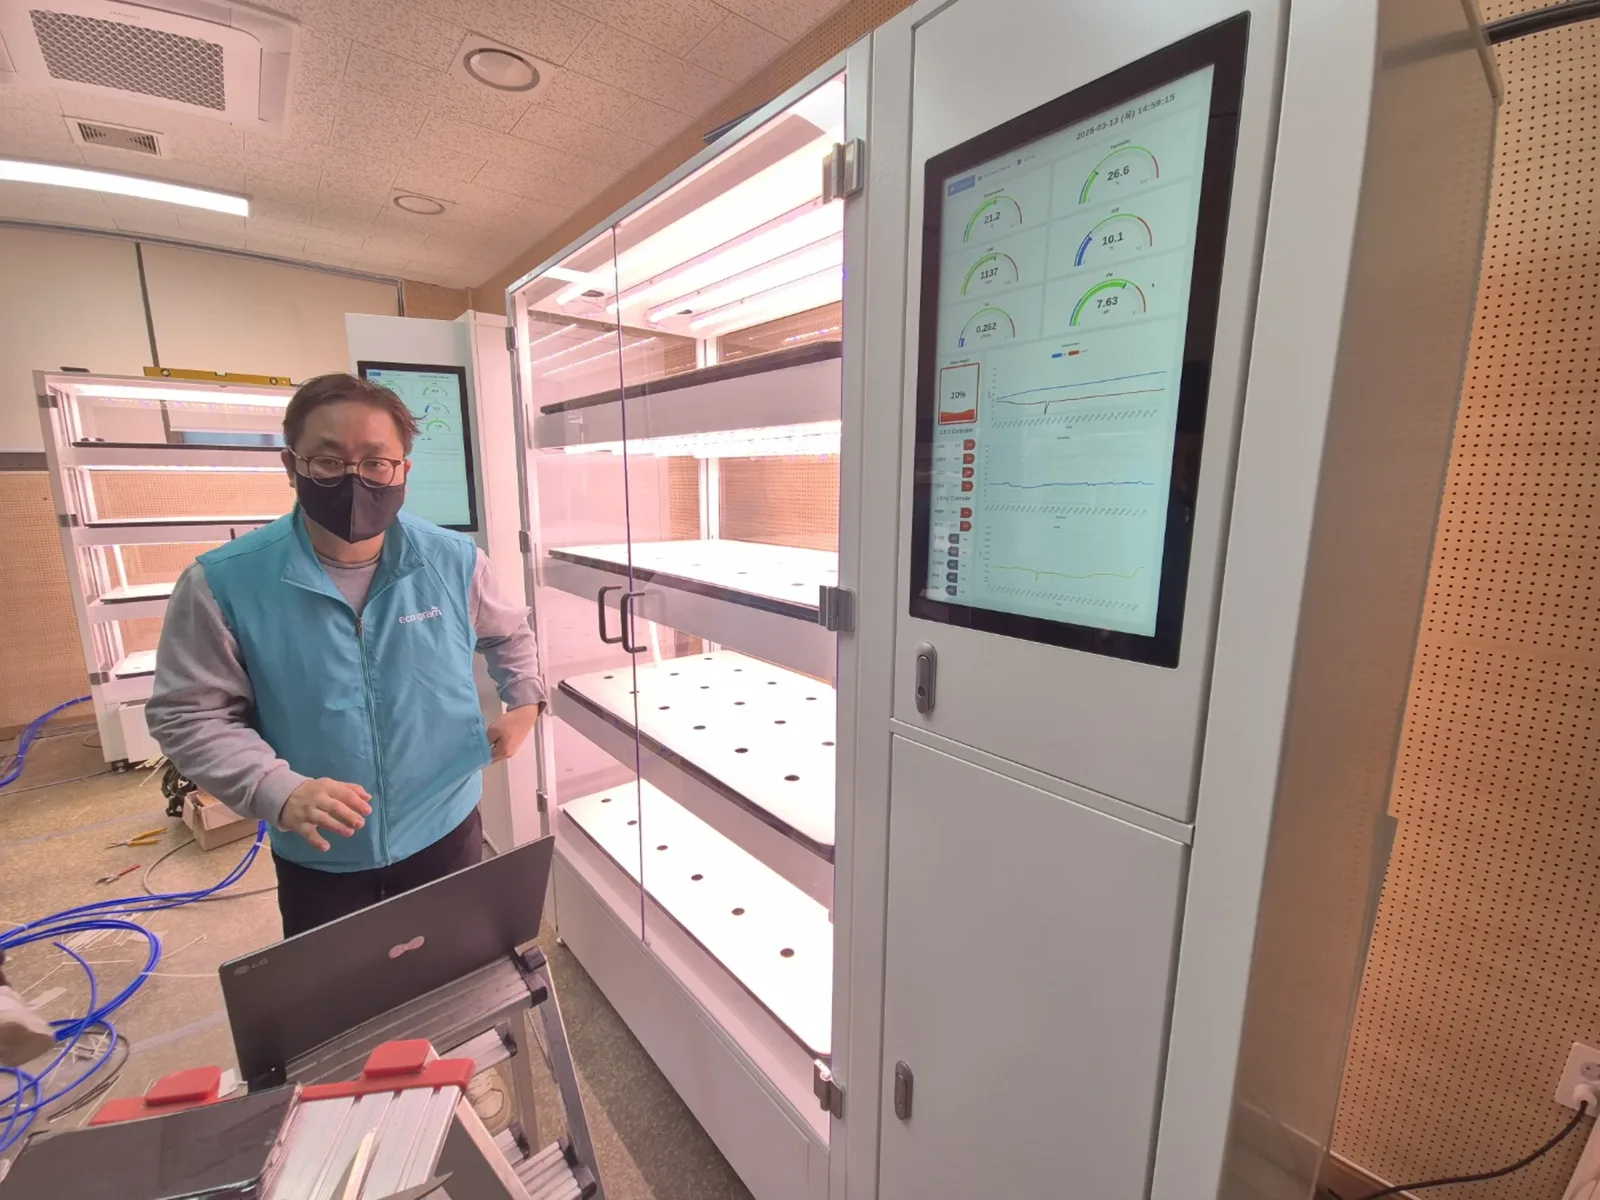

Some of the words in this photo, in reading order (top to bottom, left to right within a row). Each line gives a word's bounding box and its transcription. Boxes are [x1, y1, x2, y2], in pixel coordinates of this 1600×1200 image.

[1076, 117, 1119, 140] 2025-03-13
[1137, 93, 1176, 115] 14:59:15
[1107, 165, 1130, 182] 26.6
[984, 211, 1001, 224] 21.2
[1101, 232, 1124, 246] 10.1
[980, 267, 999, 280] 1137
[1096, 296, 1119, 308] 7.63
[950, 390, 967, 400] 20%
